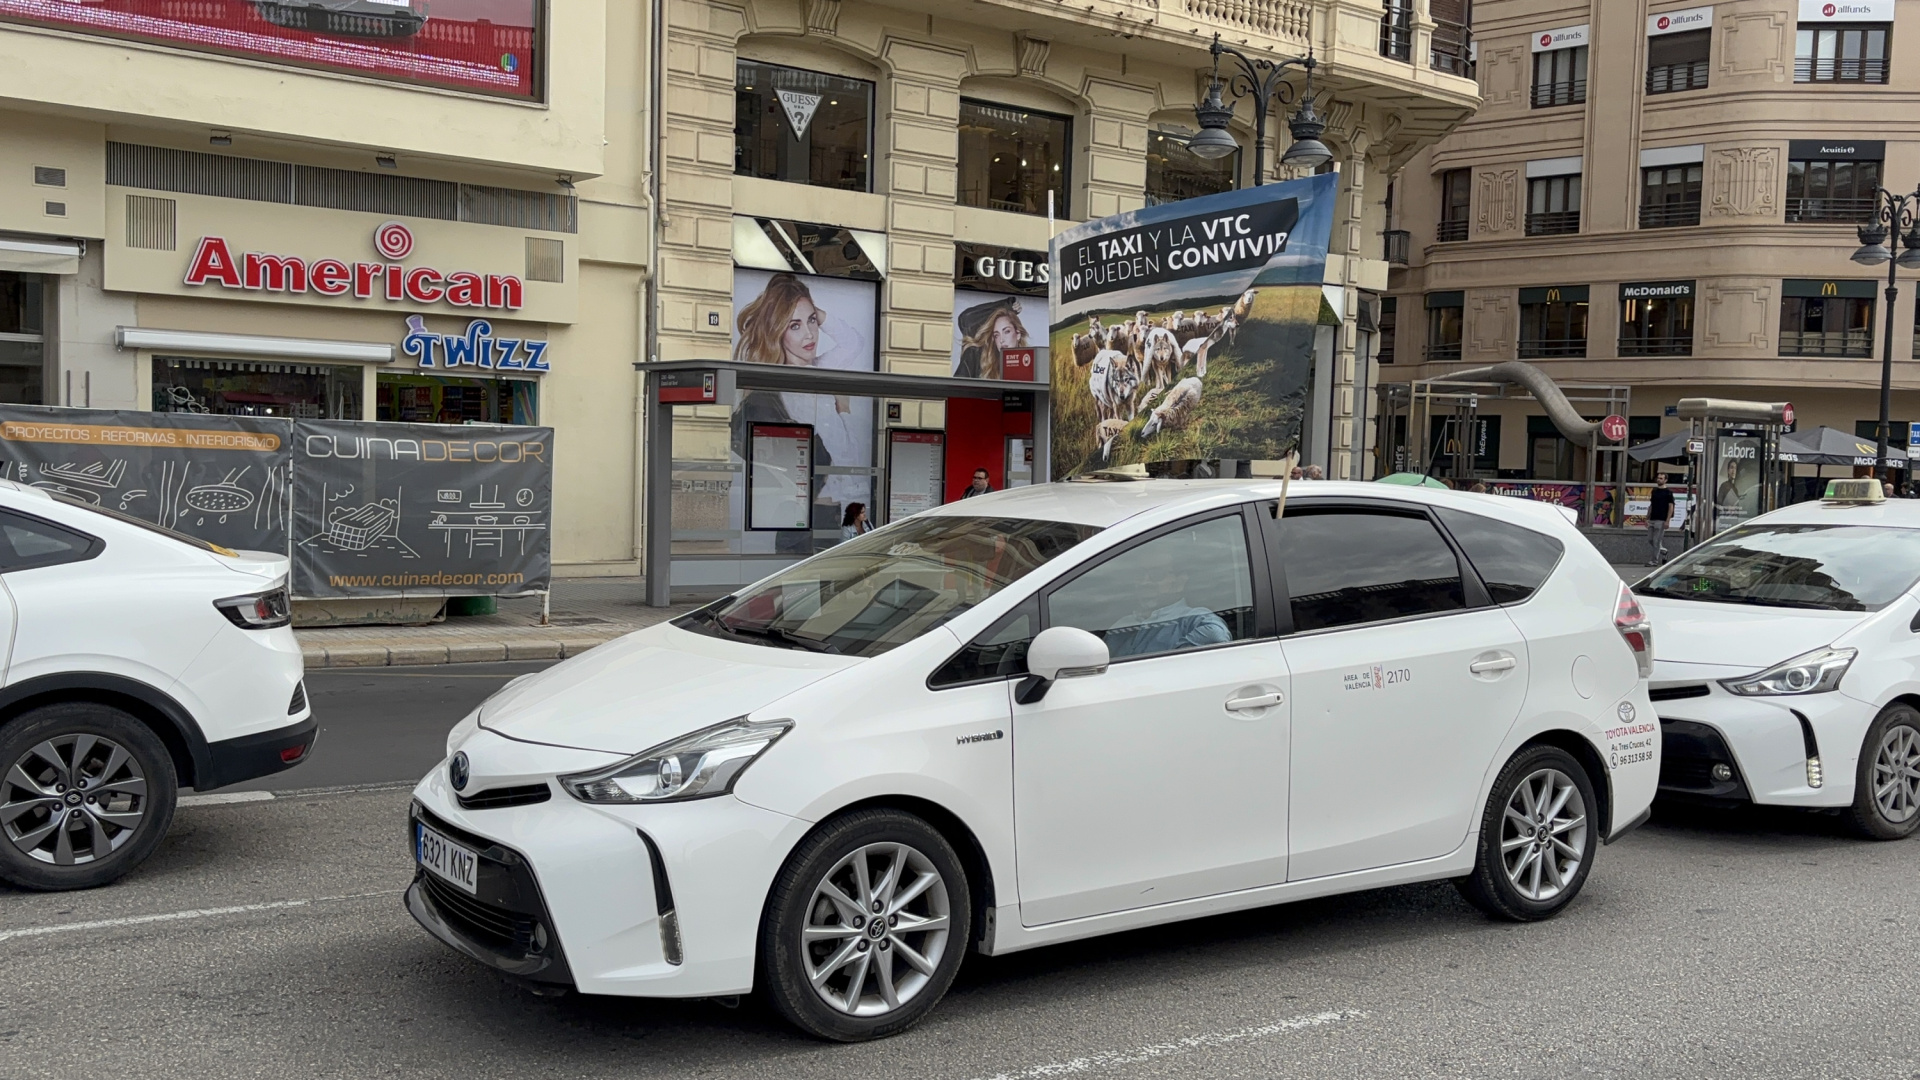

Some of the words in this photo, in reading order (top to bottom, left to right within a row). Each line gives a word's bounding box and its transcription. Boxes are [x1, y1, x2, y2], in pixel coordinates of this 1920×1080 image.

[1837, 5, 1871, 14] allfunds
[1670, 13, 1703, 25] allfunds
[1552, 31, 1582, 42] allfunds
[1079, 247, 1095, 267] EL
[1099, 233, 1143, 260] TAXI
[1148, 229, 1162, 250] Y
[1169, 225, 1196, 247] LA
[1202, 214, 1251, 240] VTC
[184, 222, 524, 310] American
[977, 256, 1049, 284] GUES
[1064, 272, 1081, 294] NO
[1085, 254, 1160, 287] PUEDEN
[1624, 285, 1690, 297] McDonald's
[5, 426, 90, 441] PROYECTOS
[101, 430, 176, 444] REFORMAS
[186, 433, 275, 449] INTERIORISMO
[1479, 420, 1487, 456] McExpress
[1722, 441, 1756, 459] Labora
[1493, 487, 1529, 497] Mamá
[1531, 487, 1562, 498] Vieja
[1837, 483, 1859, 496] TAXI
[329, 571, 525, 587] www.cuinadecor.com
[1362, 672, 1370, 680] DE
[1386, 668, 1411, 684] 2170
[1605, 727, 1629, 740] TOYOTA
[1628, 723, 1655, 735] VALENCIA
[1619, 742, 1629, 751] Tres
[1646, 738, 1652, 746] 42
[1628, 753, 1638, 764] 313
[423, 833, 446, 873] 6321
[451, 848, 474, 886] KNZ
